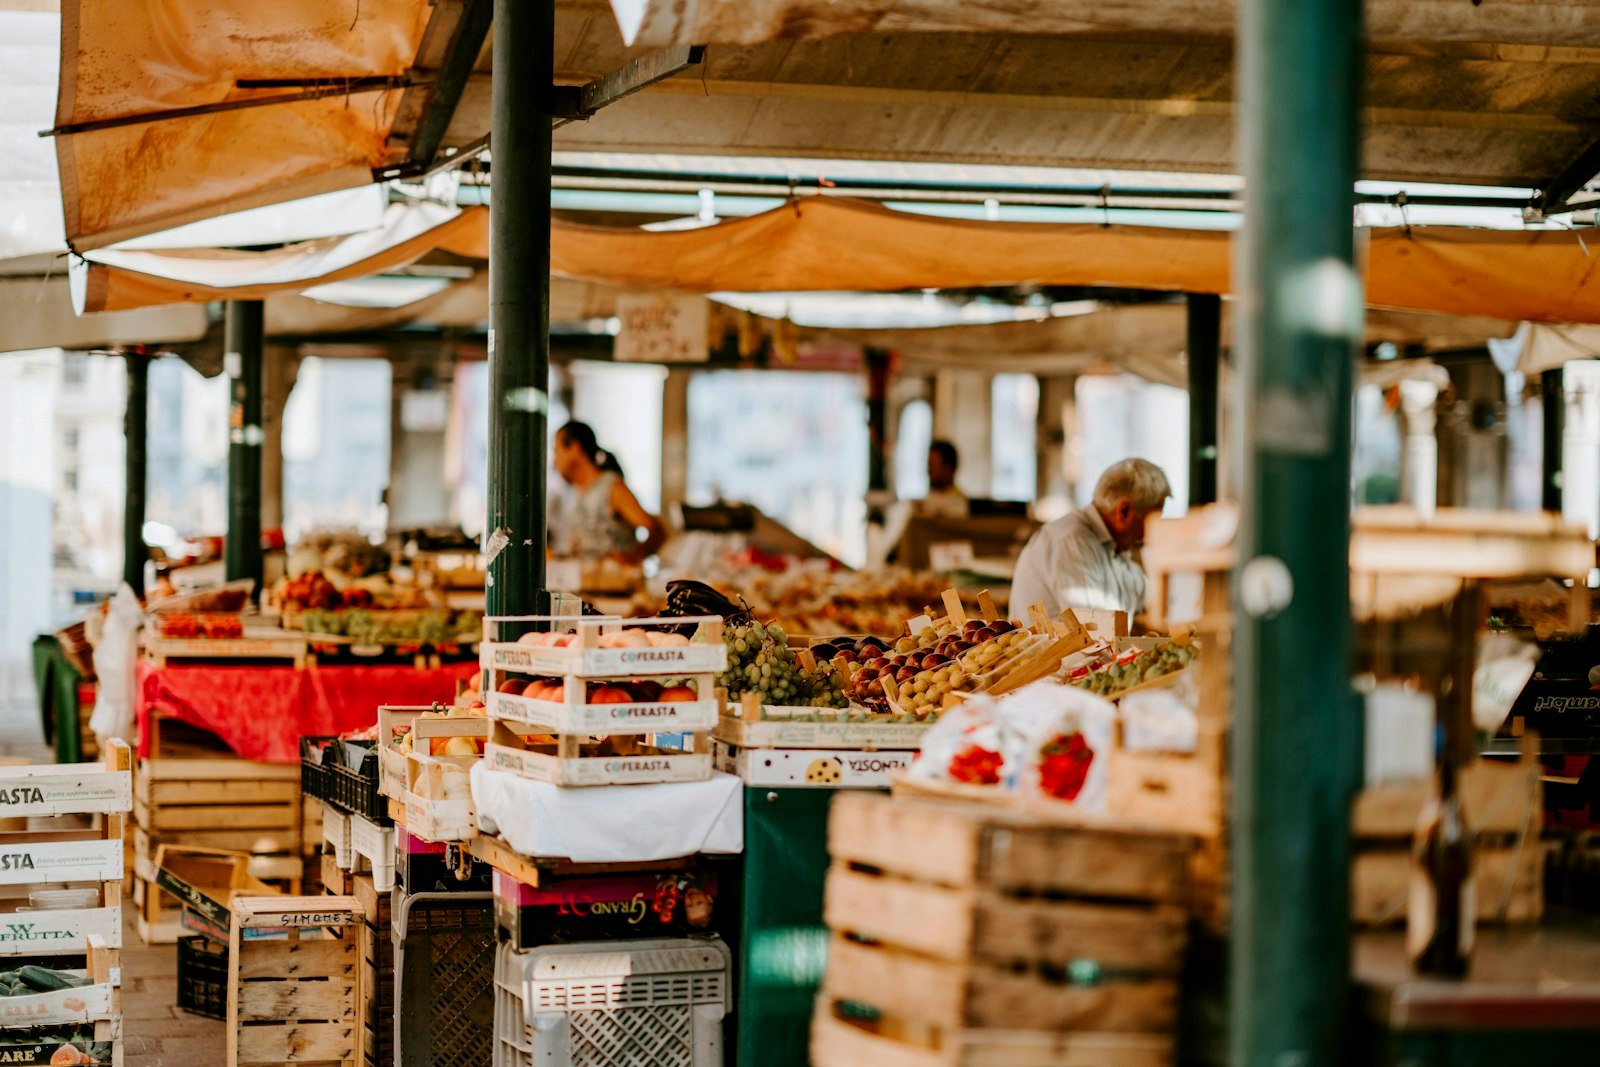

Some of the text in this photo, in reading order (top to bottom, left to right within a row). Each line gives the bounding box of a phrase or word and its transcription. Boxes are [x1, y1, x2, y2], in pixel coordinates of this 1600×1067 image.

[621, 651, 685, 662] COFERASTA
[1534, 696, 1600, 713] embri
[611, 707, 676, 718] COFERASTA
[604, 760, 671, 772] COFERASTA
[0, 853, 35, 871] STA
[591, 892, 647, 924] GRAND
[0, 930, 76, 941] FRUTTA
[0, 1050, 35, 1062] ARE
